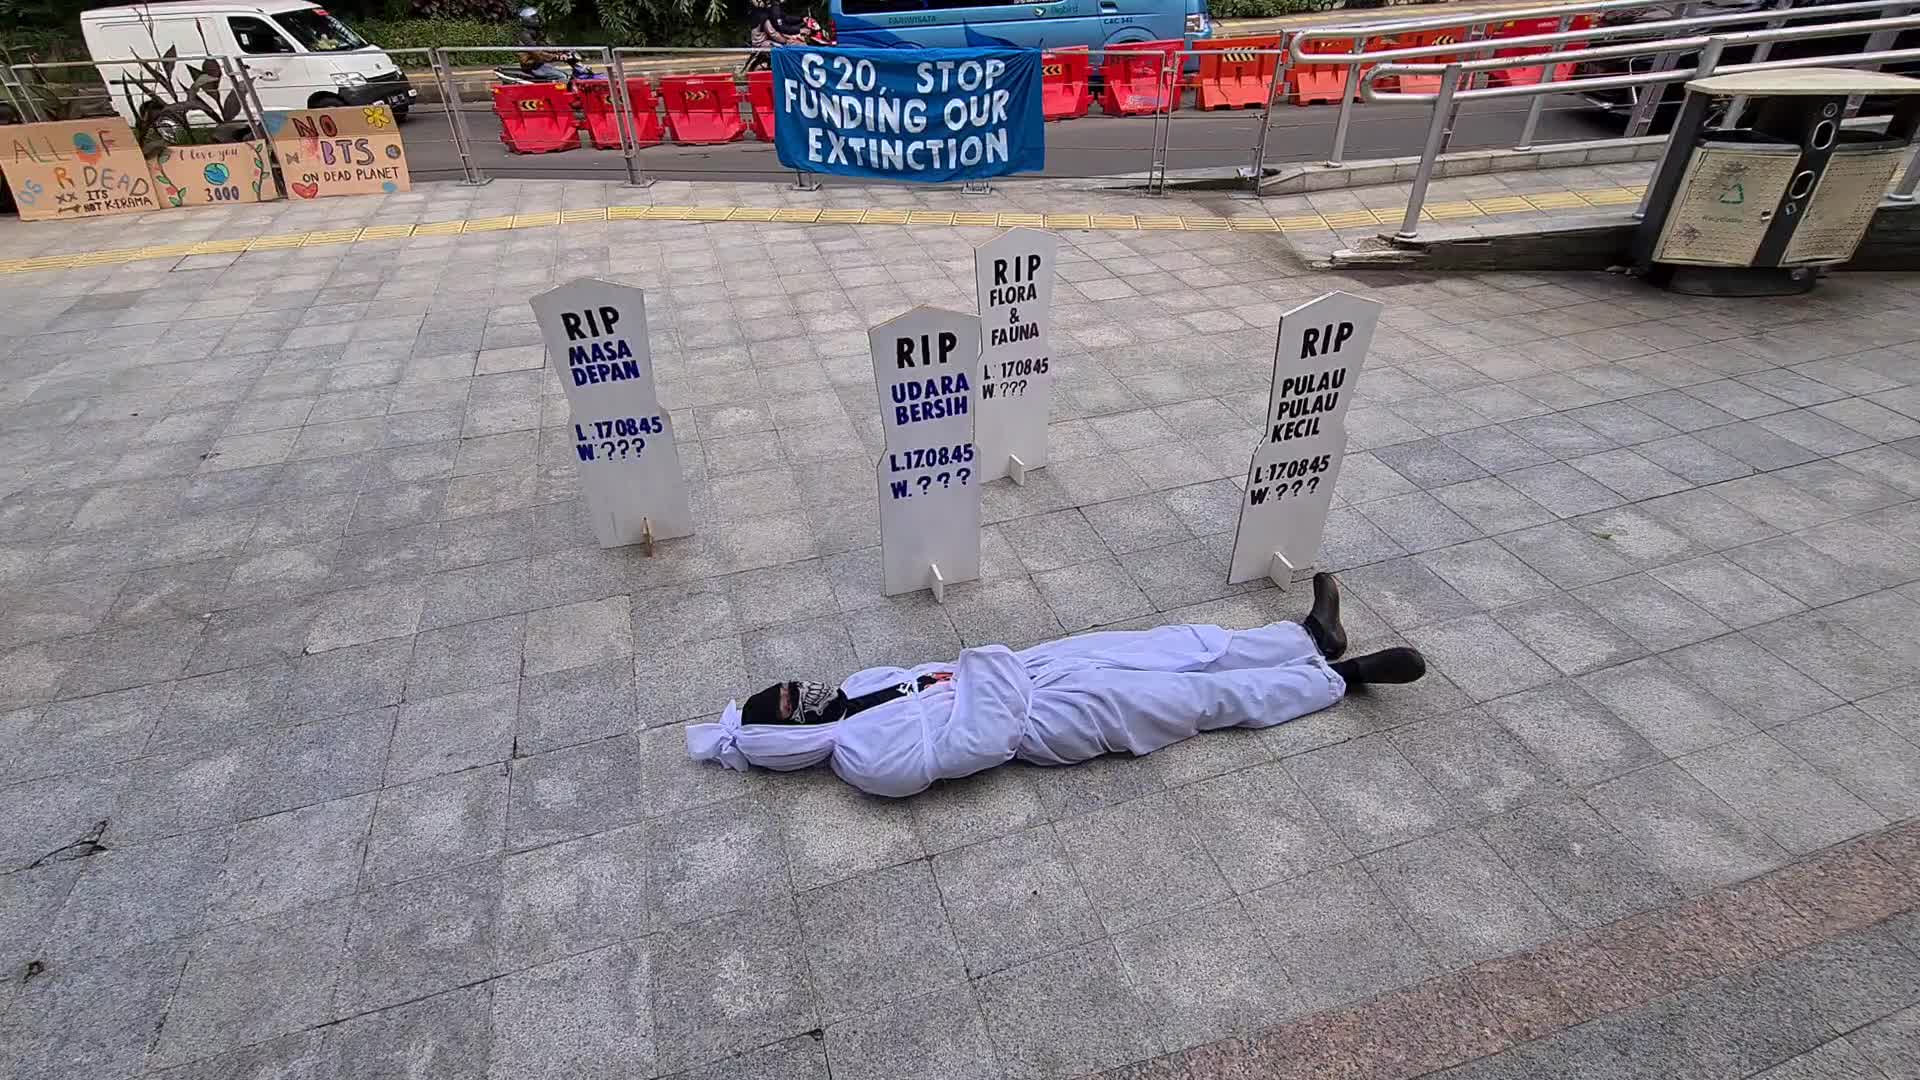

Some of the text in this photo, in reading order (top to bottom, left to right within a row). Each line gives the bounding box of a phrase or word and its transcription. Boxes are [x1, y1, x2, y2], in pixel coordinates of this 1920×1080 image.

[916, 59, 1006, 94] STOP
[785, 78, 1010, 134] FUNDING OUR
[292, 114, 338, 138] NO
[13, 135, 71, 165] ALL
[320, 138, 375, 166] BTS
[808, 127, 1009, 171] EXTINCTION
[83, 165, 149, 196] DEAD
[302, 166, 400, 183] ON DEAD PLANET
[84, 202, 103, 213] NOT
[204, 185, 240, 202] 3000
[993, 254, 1041, 287] RIP
[990, 283, 1037, 307] FLORA
[560, 306, 620, 341] RIP
[1009, 307, 1020, 325] &
[991, 322, 1040, 347] FAUNA
[1300, 321, 1354, 360] RIP
[568, 339, 632, 367] MASA
[896, 331, 957, 369] RIP
[571, 359, 641, 387] DEPAN
[891, 372, 970, 403] UDARA
[1281, 367, 1346, 398] PULAU
[895, 395, 968, 426] BERSIH
[1277, 391, 1339, 421] PULAU
[1271, 416, 1320, 443] KECIL
